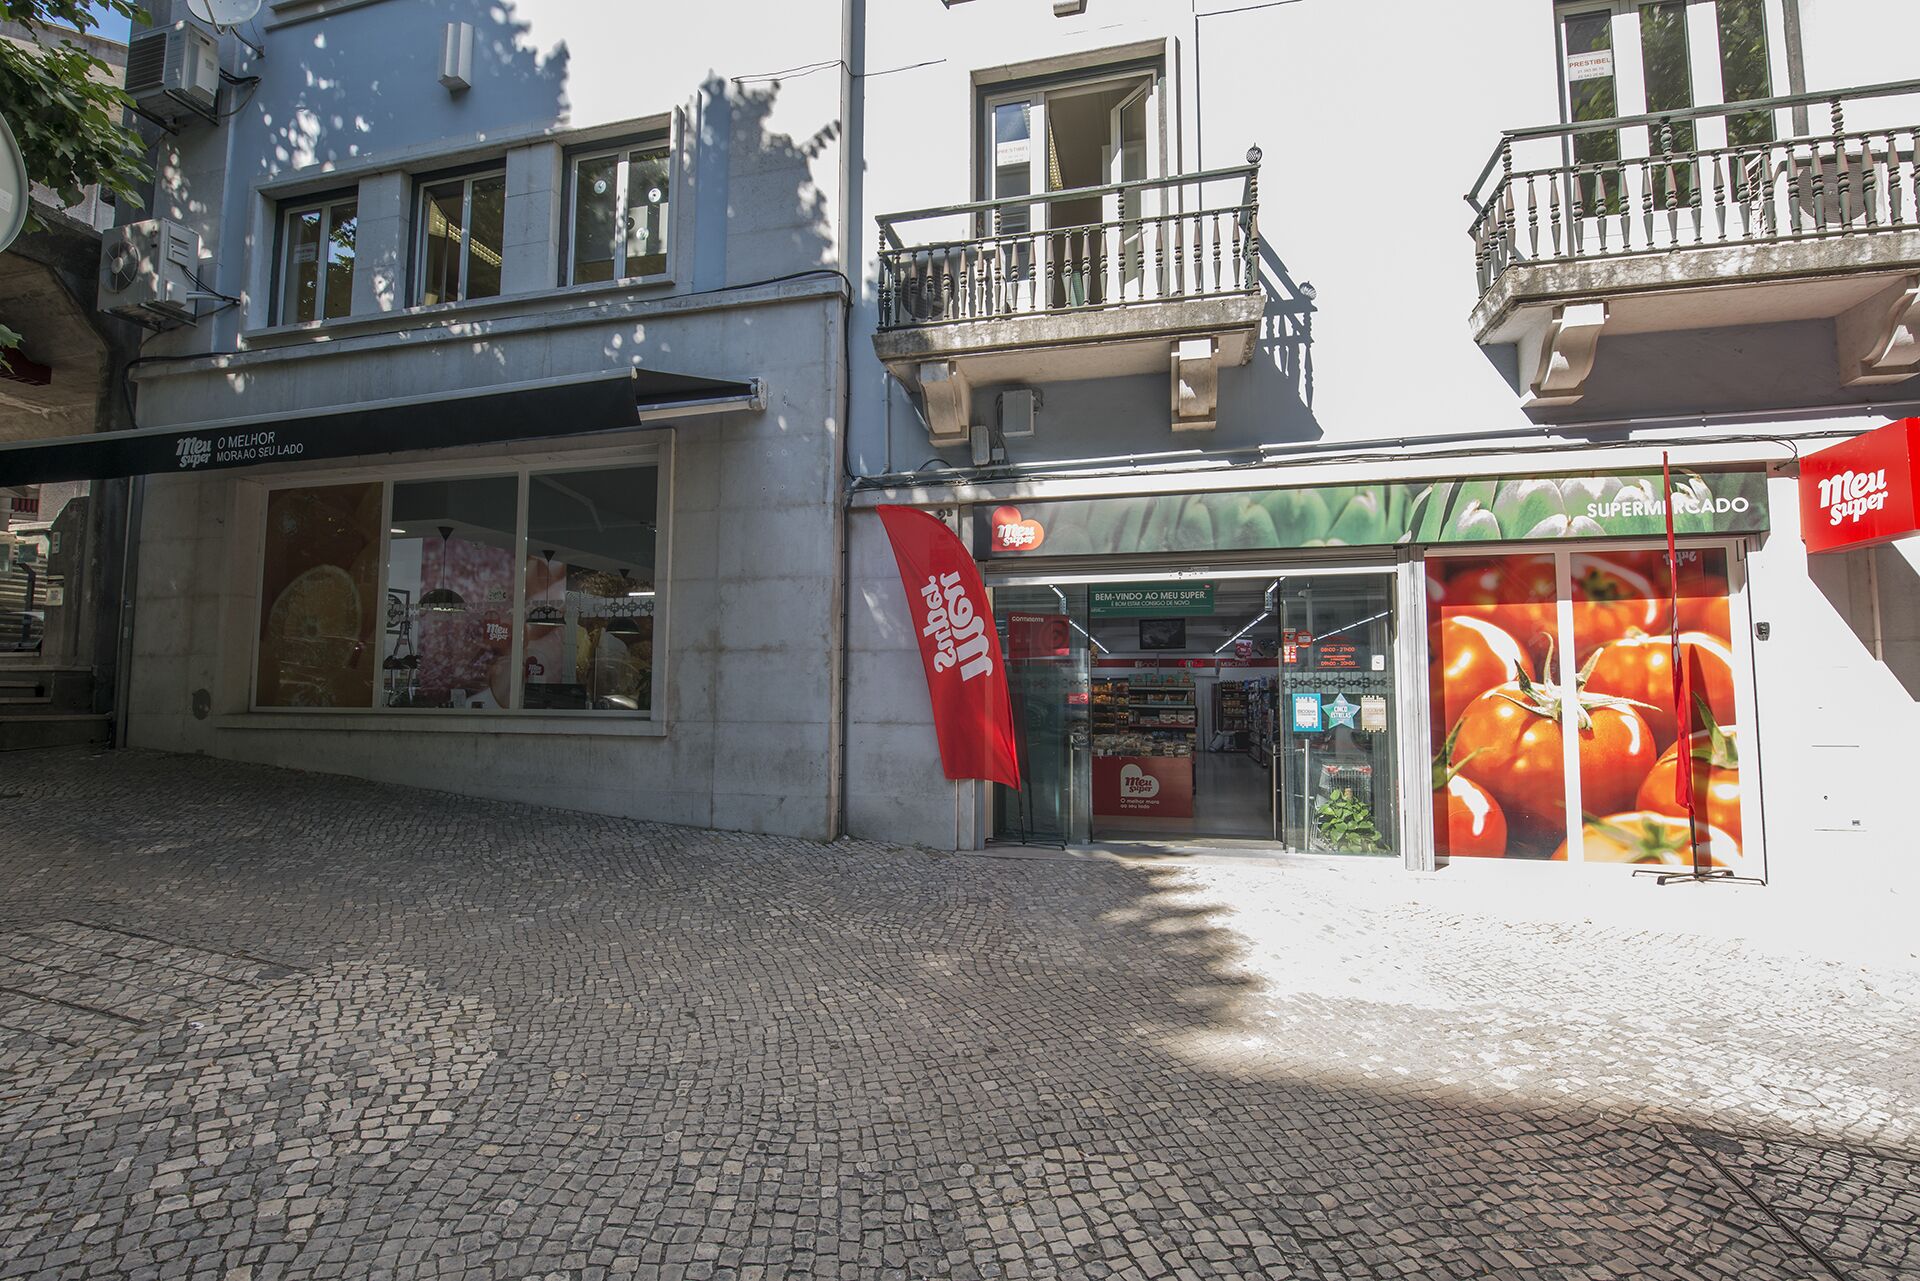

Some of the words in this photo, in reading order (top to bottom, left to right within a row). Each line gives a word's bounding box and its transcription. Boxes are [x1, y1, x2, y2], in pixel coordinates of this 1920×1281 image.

[1569, 57, 1611, 68] PRESTIBEL
[176, 437, 212, 455] Meu
[217, 436, 226, 449] O
[228, 431, 275, 449] MELHOR
[258, 446, 275, 458] SEU
[277, 443, 304, 455] LADO
[180, 453, 211, 468] super
[1818, 469, 1887, 509] Meu
[1587, 497, 1750, 518] SUPERMRCADO
[1829, 491, 1889, 526] super
[997, 524, 1035, 539] Meu
[1003, 536, 1035, 547] super
[1095, 592, 1143, 601] BEM-VINDO
[1145, 592, 1158, 600] AO
[1160, 591, 1178, 600] MEU
[1180, 591, 1207, 599] SUPER.
[486, 623, 508, 634] Meu
[920, 575, 957, 673] super
[939, 571, 993, 682] Meu
[1125, 777, 1152, 786] Meu
